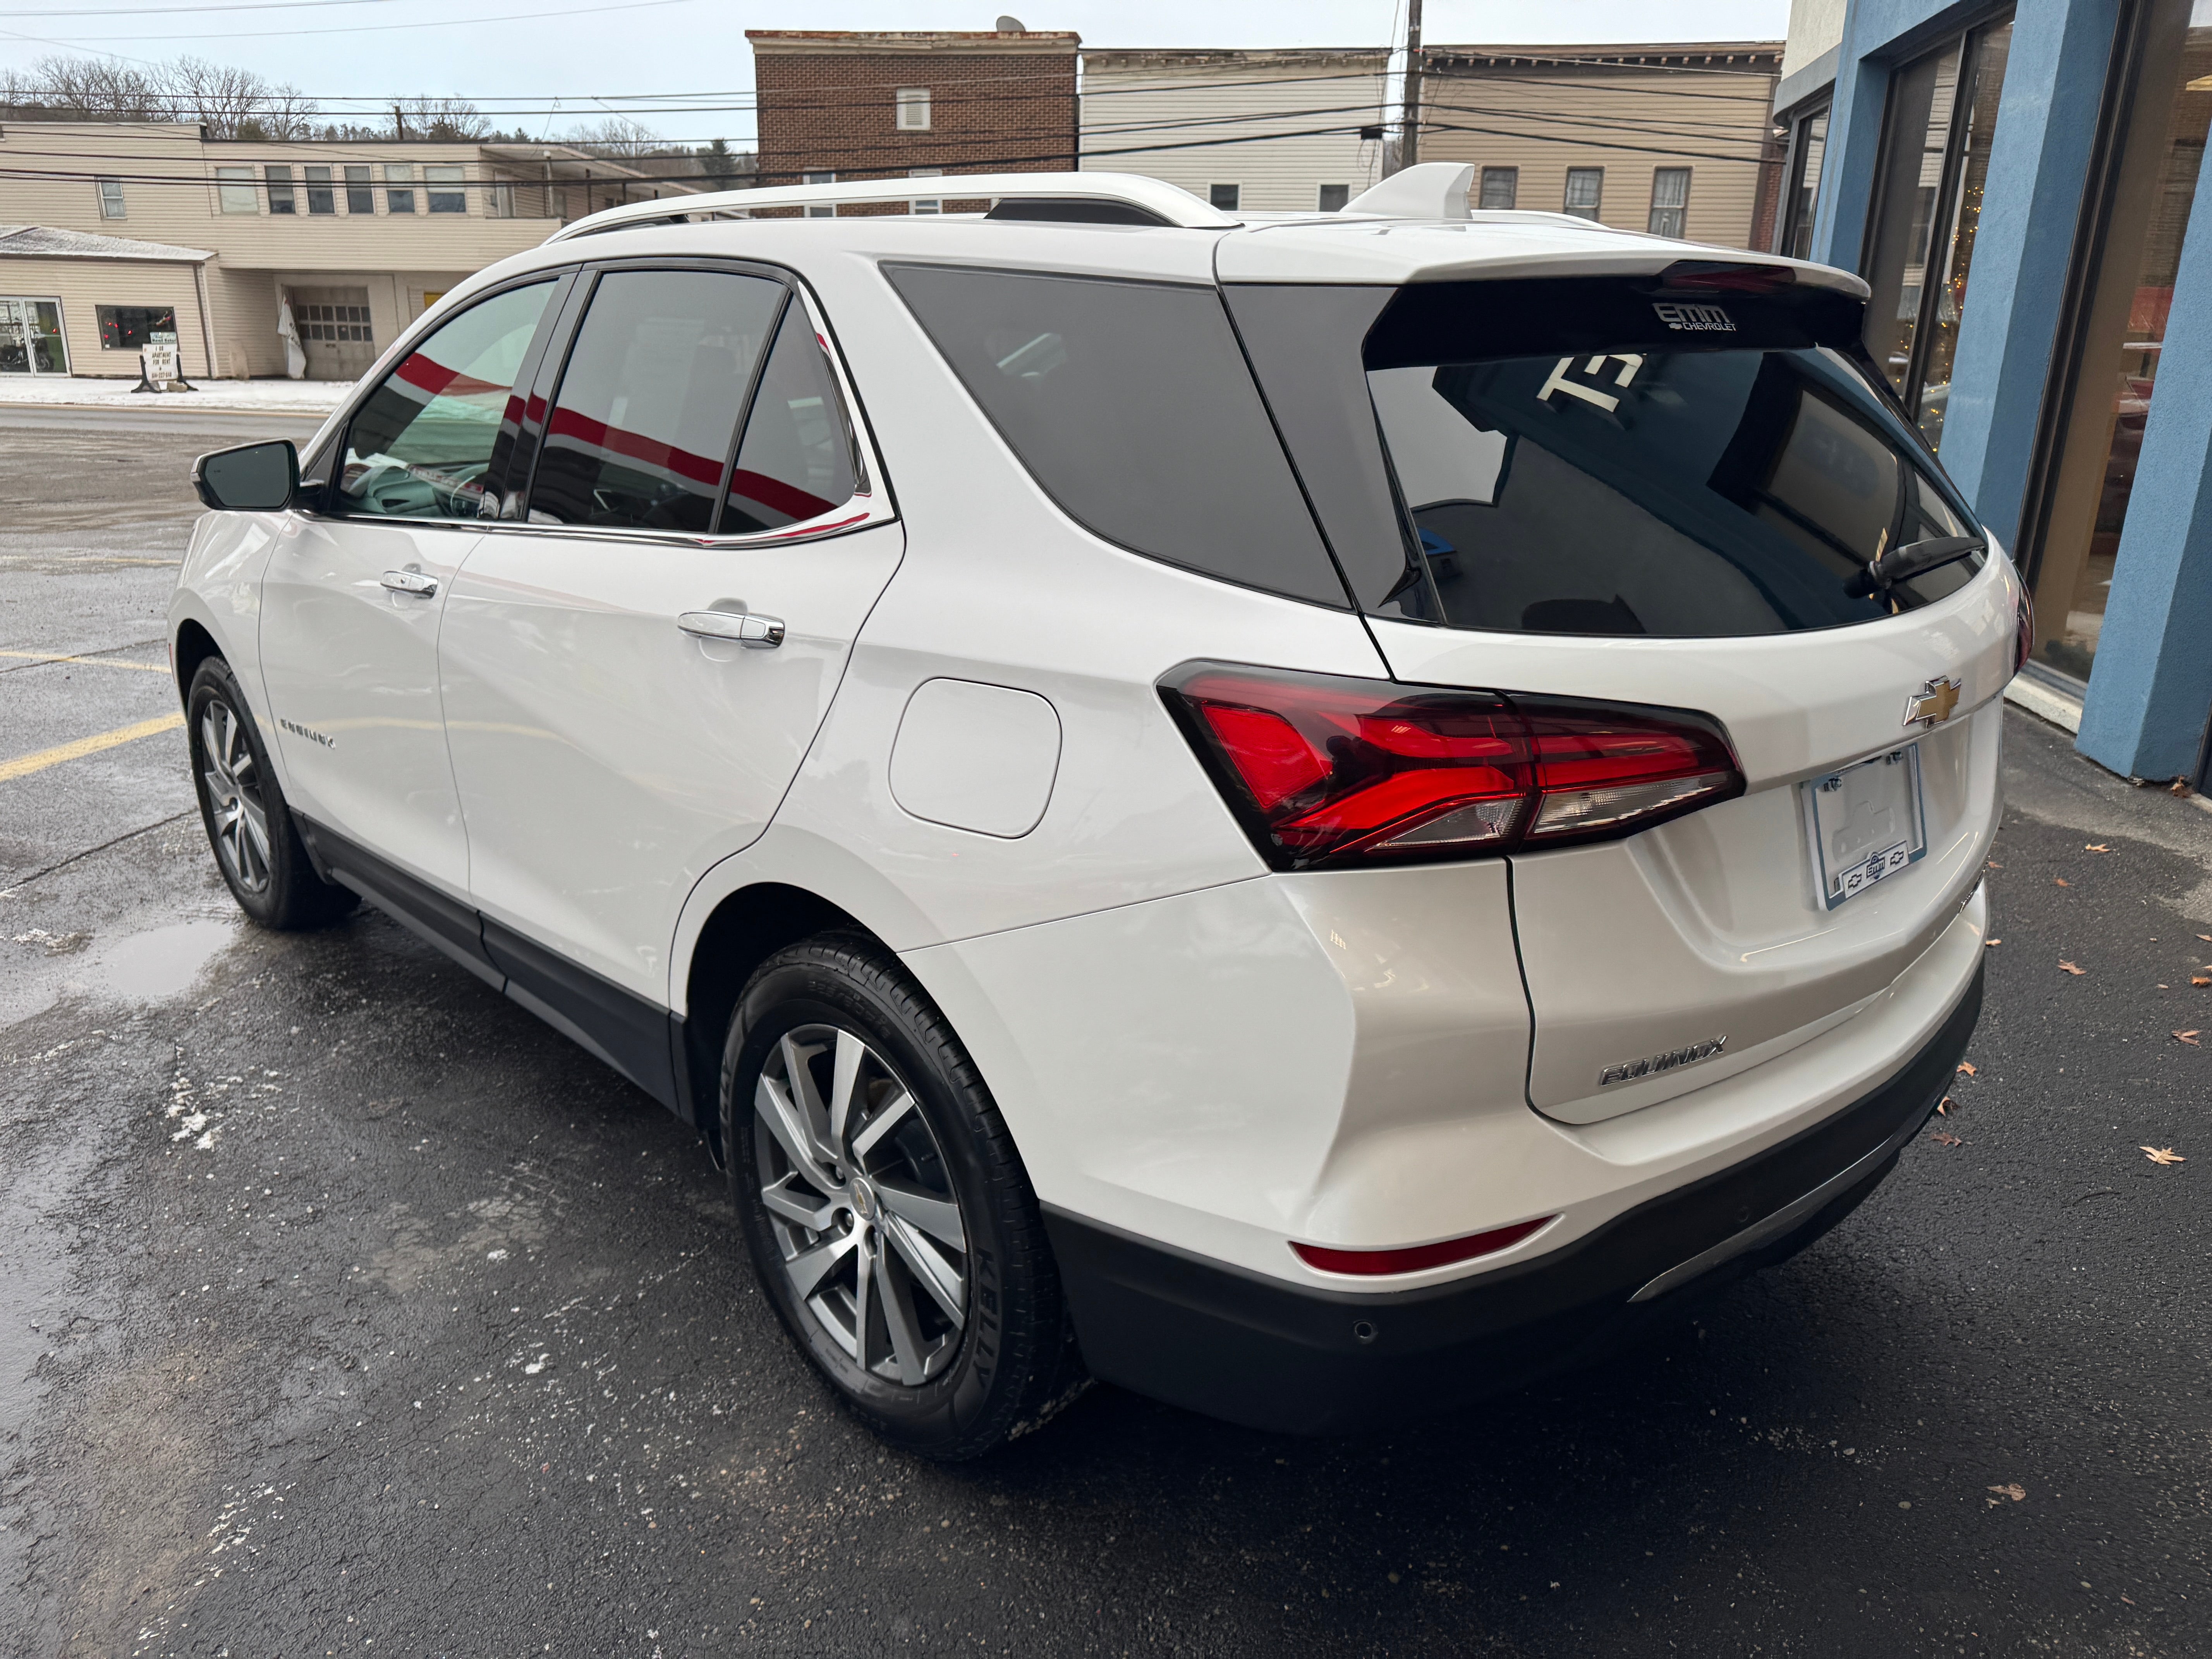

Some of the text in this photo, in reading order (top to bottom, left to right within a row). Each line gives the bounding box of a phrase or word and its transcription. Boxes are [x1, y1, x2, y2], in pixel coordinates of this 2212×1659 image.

[1652, 303, 1731, 323] Emm
[1682, 322, 1736, 331] CHEVROLET
[1599, 1036, 1728, 1086] EQUINOX
[972, 1246, 998, 1389] KELLY
